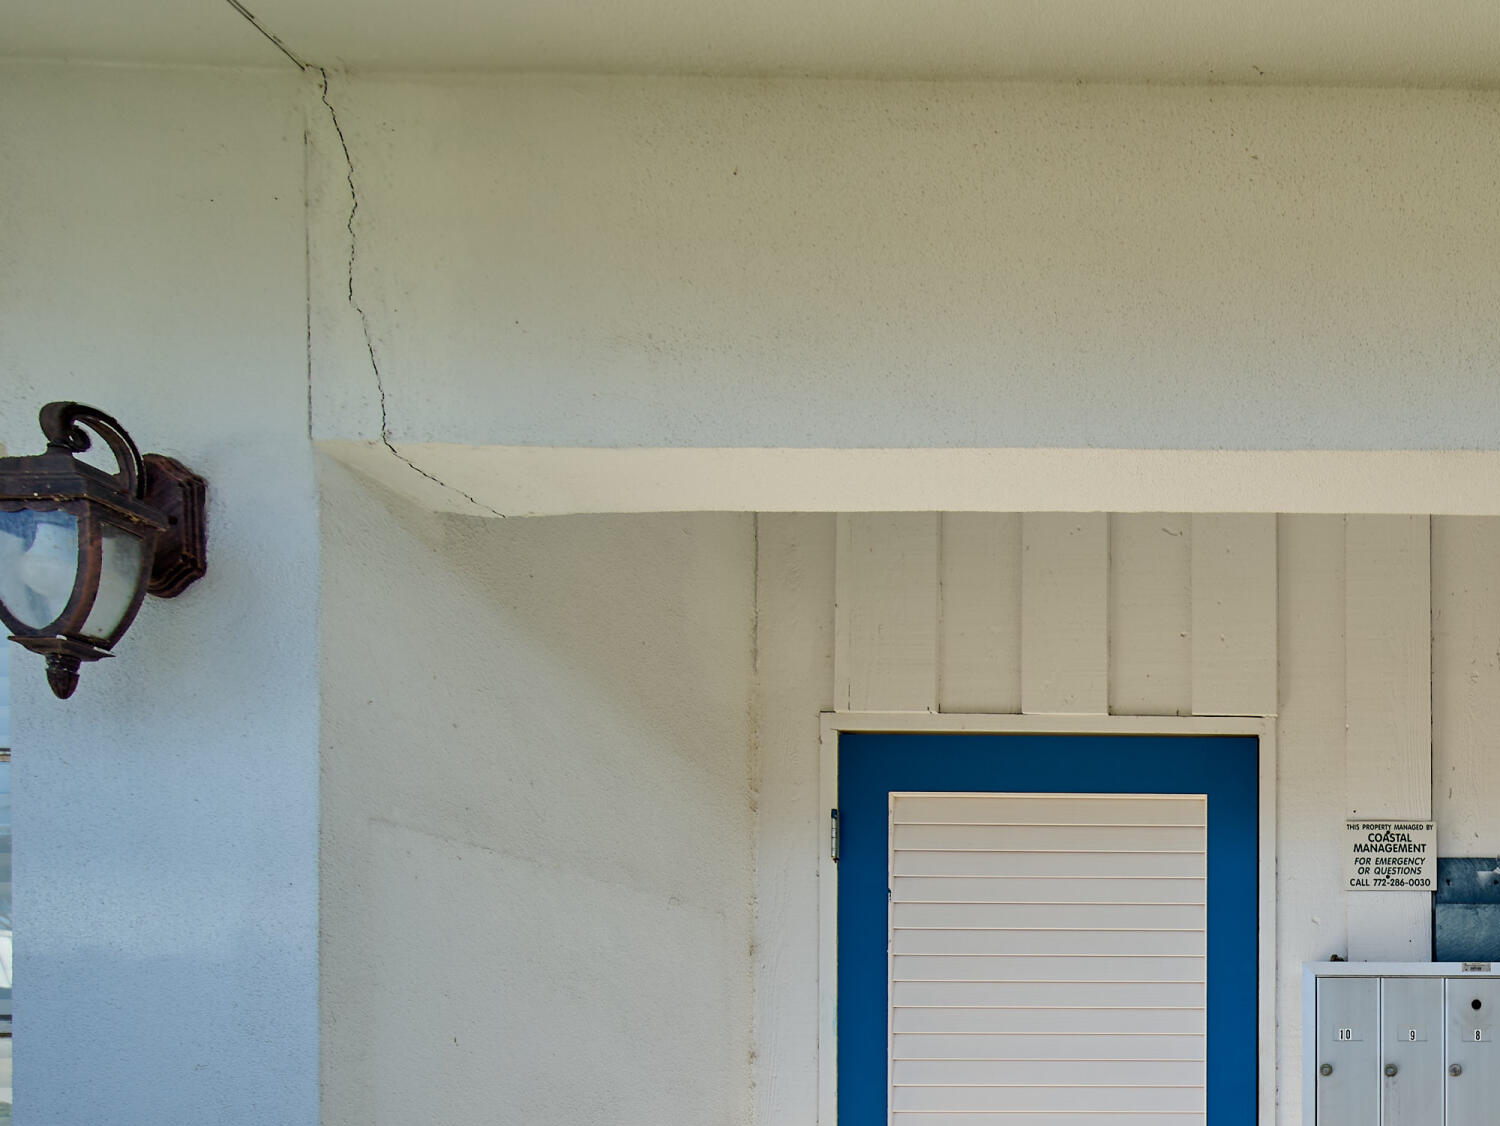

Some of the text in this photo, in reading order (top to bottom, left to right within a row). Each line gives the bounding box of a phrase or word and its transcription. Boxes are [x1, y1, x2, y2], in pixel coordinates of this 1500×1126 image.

[1368, 833, 1412, 843] COASTAL
[1353, 844, 1427, 853] MANAGEMENT
[1354, 857, 1426, 866] FOR EMERGENCY
[1358, 867, 1422, 876] OR QUESTIONS
[1350, 878, 1431, 887] CALL 772-286-0030
[1340, 1029, 1351, 1040] 10
[1410, 1030, 1415, 1040] 9
[1475, 1030, 1480, 1040] 8
